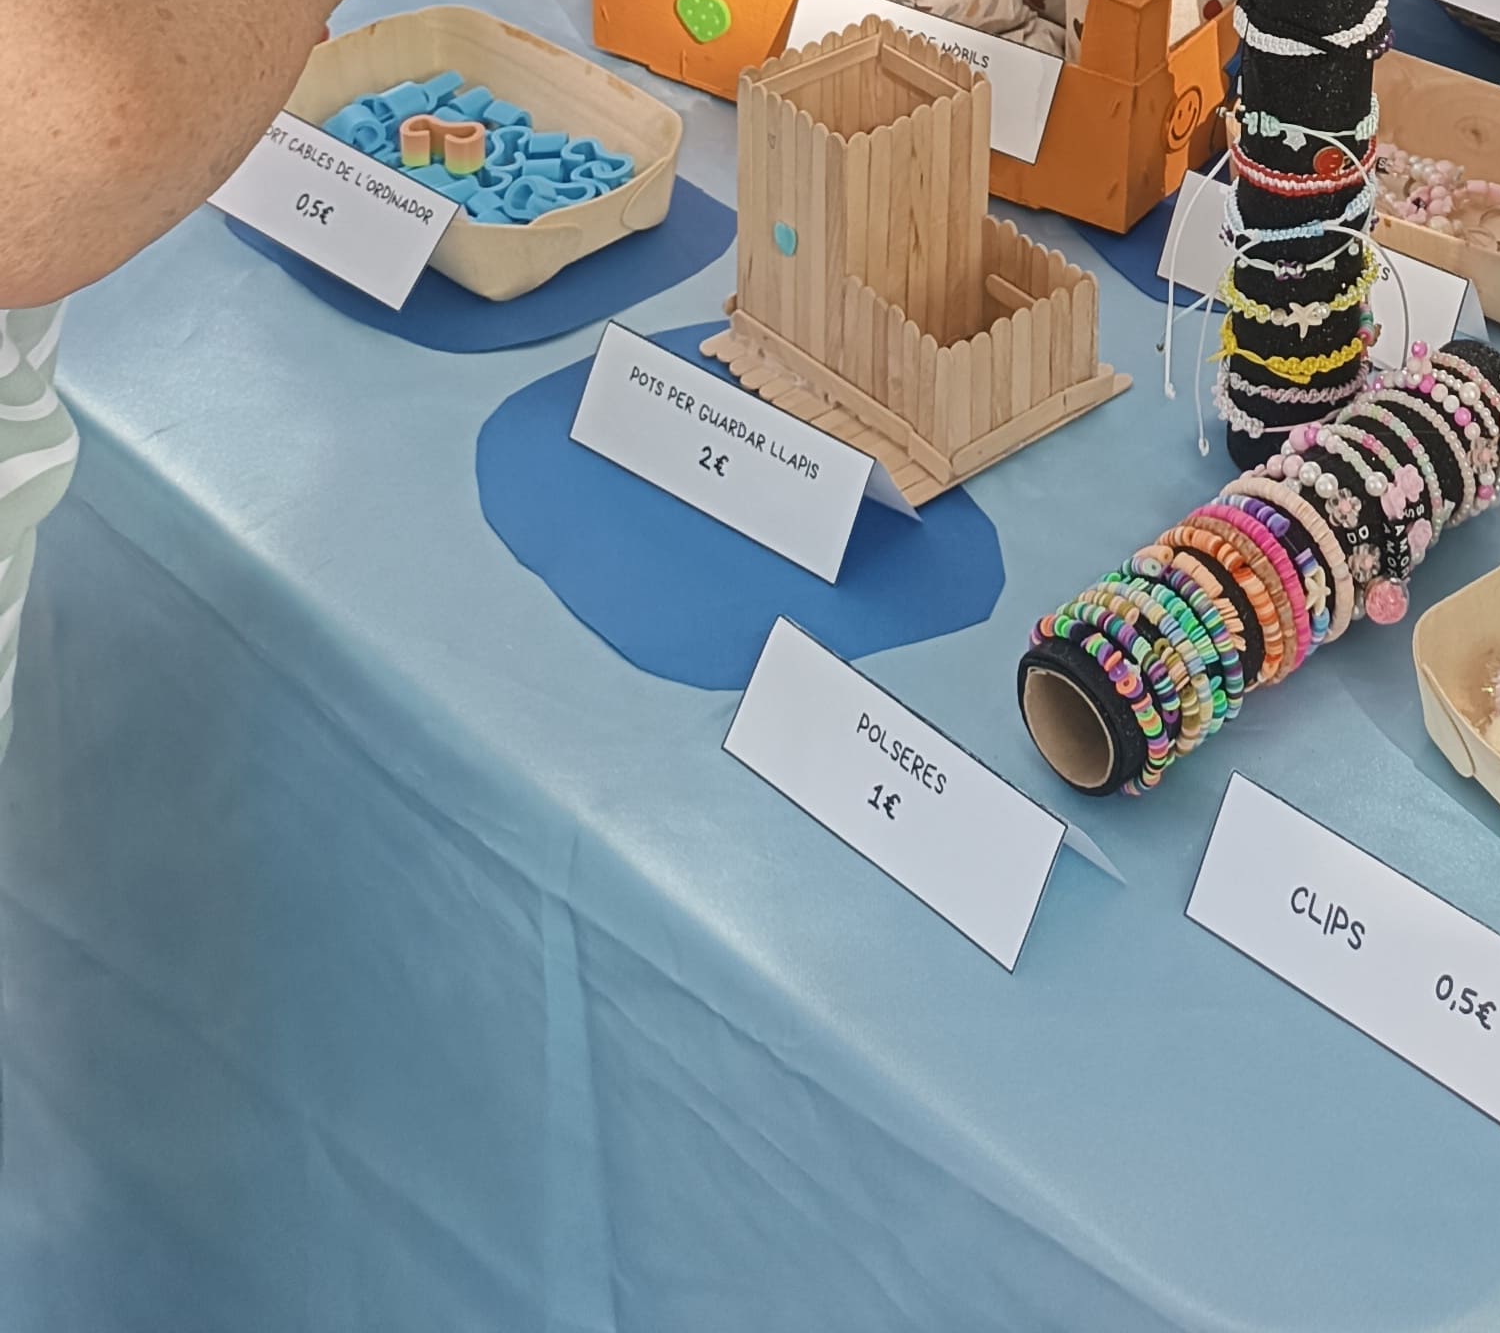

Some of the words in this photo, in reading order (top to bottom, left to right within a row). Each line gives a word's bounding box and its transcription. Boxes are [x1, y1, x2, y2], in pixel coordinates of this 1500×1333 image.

[287, 136, 335, 171] CABLES
[335, 160, 355, 183] DE
[354, 171, 435, 226] L'ORDINADOR
[295, 192, 335, 226] 0,5€
[628, 365, 666, 397] POTS
[667, 385, 696, 415] PER
[698, 403, 767, 453] GUARDAR
[769, 440, 821, 481] LLAPIS
[698, 445, 730, 478] 2€
[856, 712, 948, 795] POLSERES
[867, 784, 902, 821] 1€
[1290, 886, 1366, 951] CLIPS
[1435, 973, 1498, 1031] 0,5€
